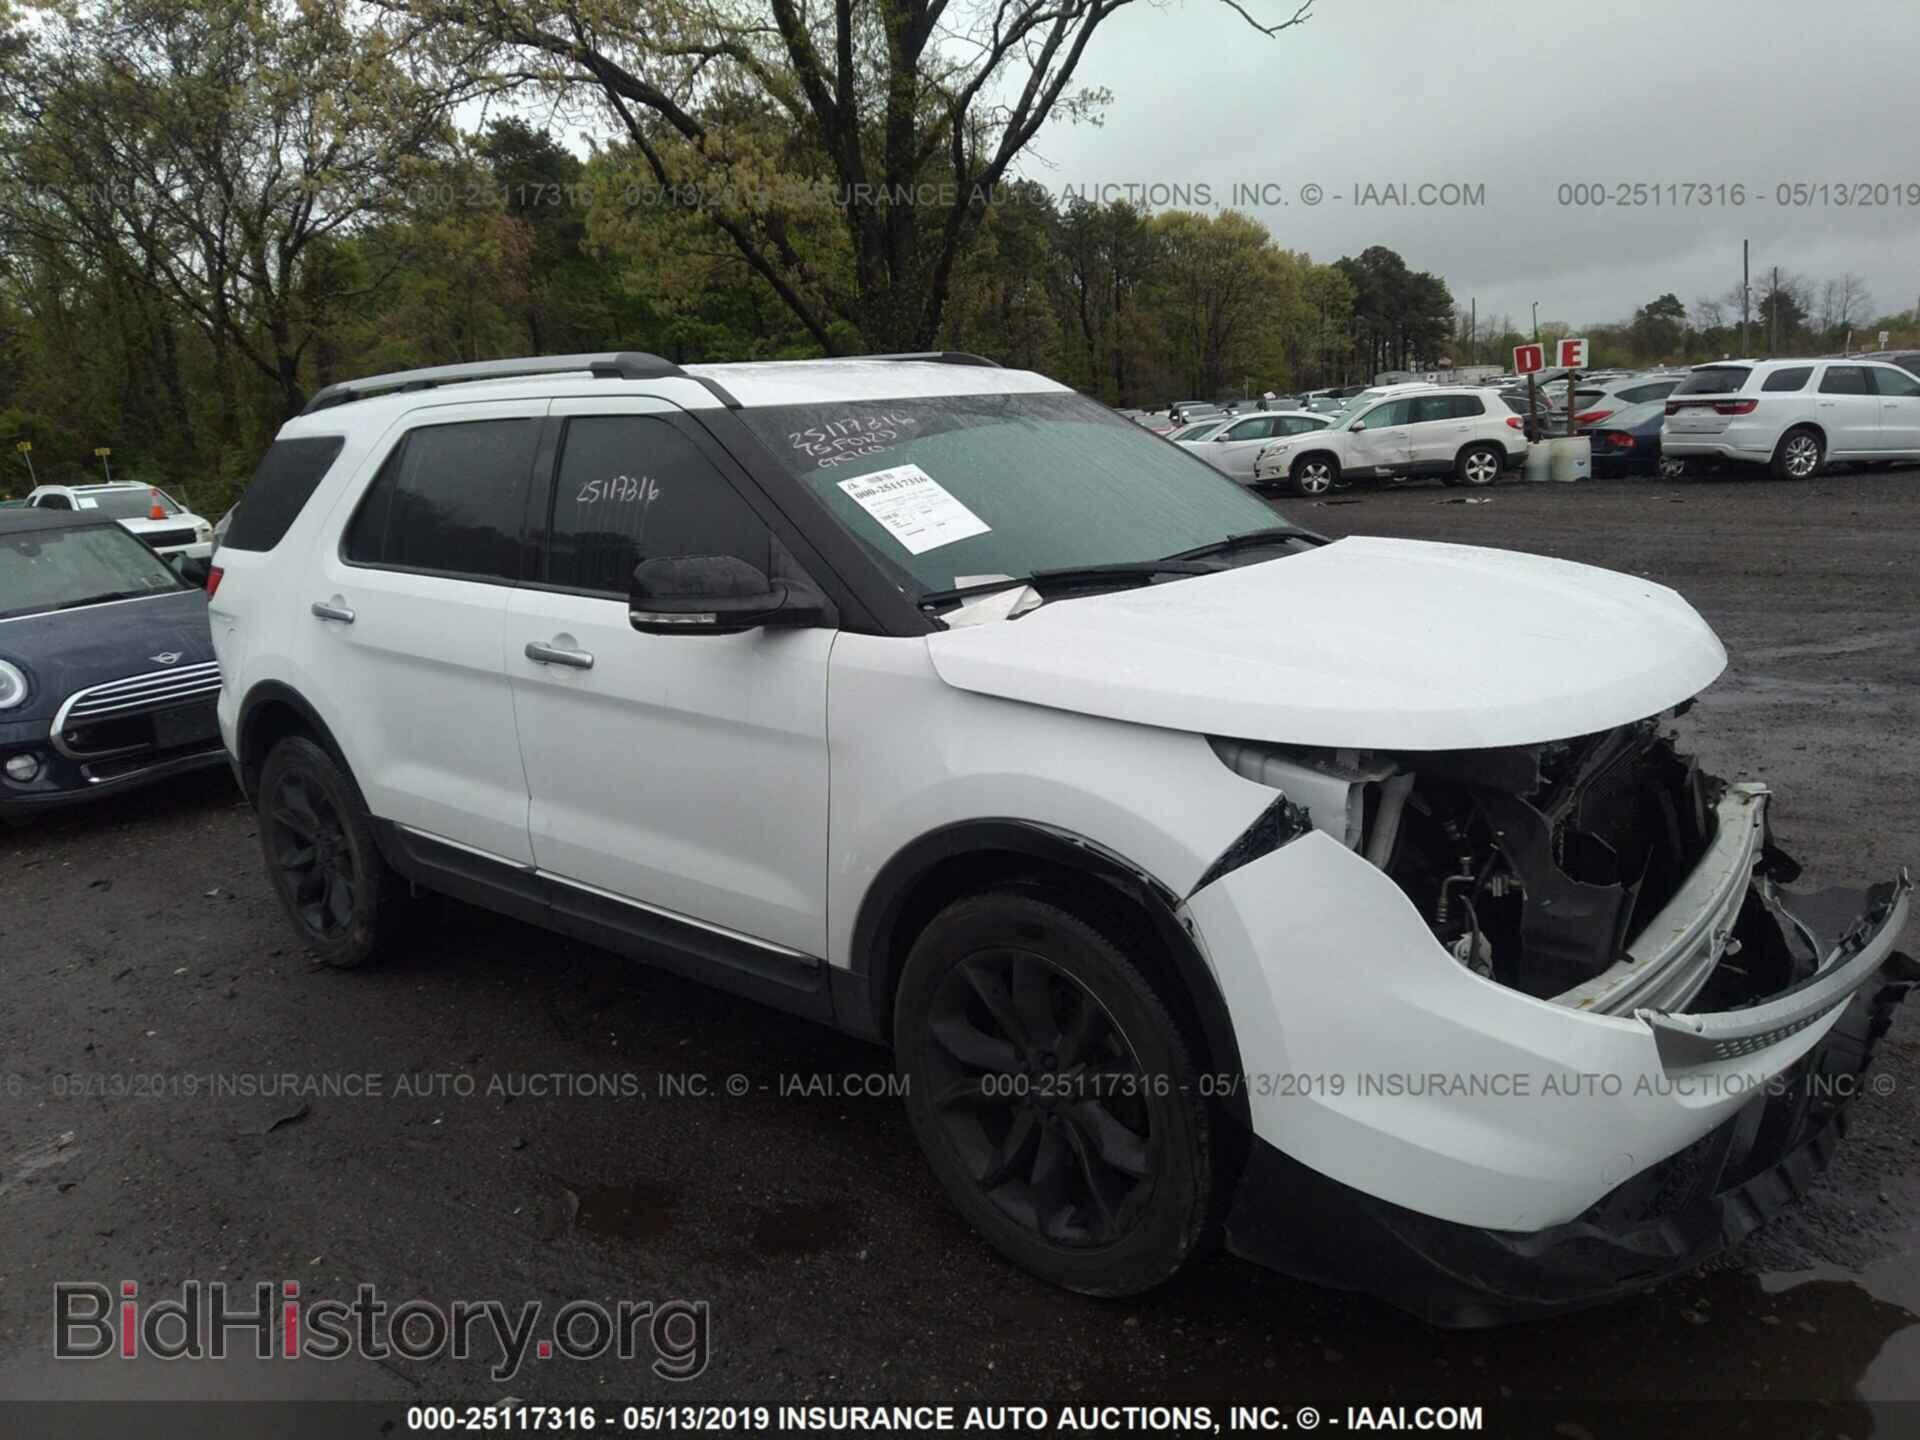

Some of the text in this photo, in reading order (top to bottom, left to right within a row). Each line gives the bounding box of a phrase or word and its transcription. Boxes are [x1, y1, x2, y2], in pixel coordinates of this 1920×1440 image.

[1516, 347, 1543, 373] D
[1562, 341, 1582, 366] E
[575, 475, 659, 503] 25117316
